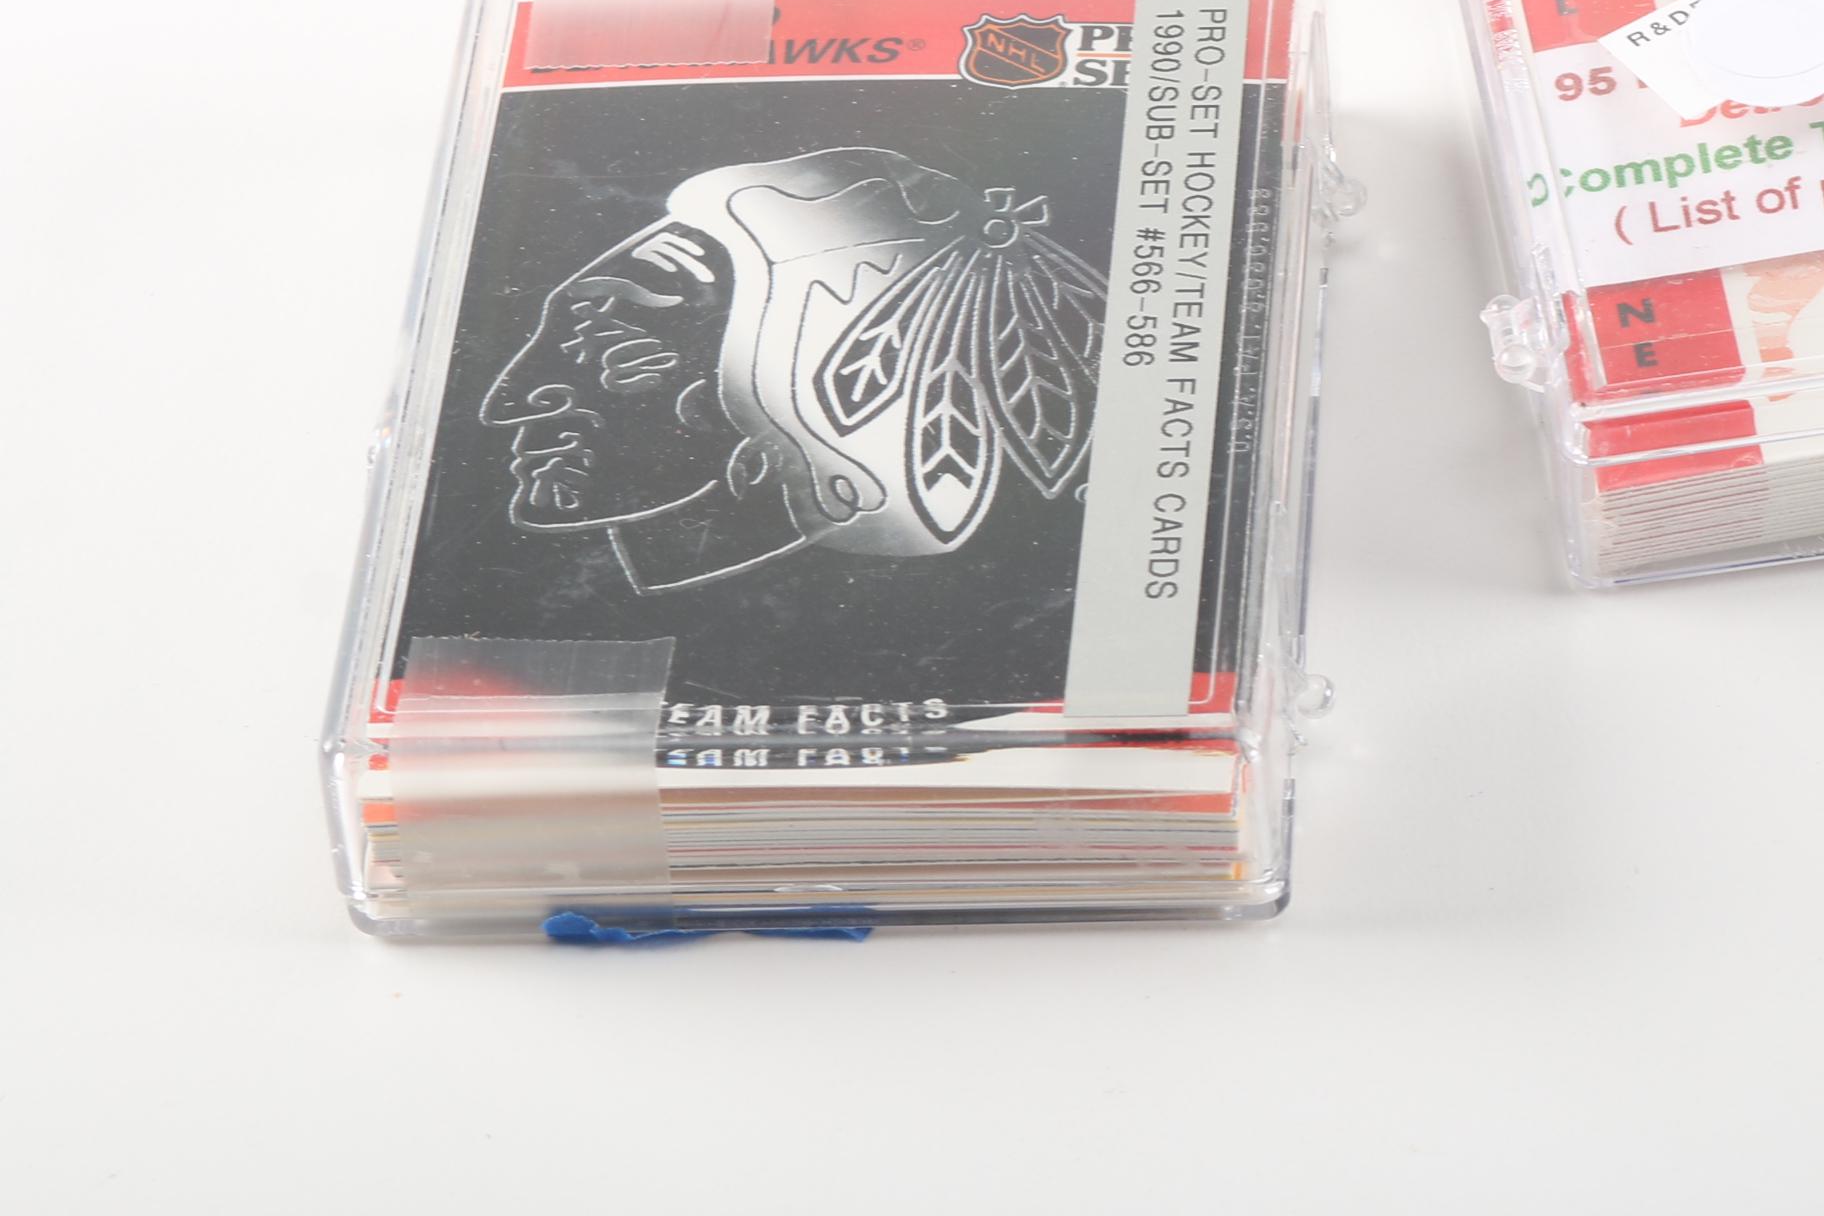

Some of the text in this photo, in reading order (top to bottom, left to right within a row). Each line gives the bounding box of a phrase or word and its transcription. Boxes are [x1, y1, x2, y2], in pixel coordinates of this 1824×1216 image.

[984, 31, 1046, 74] NHL
[1626, 30, 1652, 48] R
[1668, 9, 1690, 27] D
[1554, 67, 1619, 102] 95
[1123, 8, 1185, 368] 1990/SUB-SET #566-586
[1649, 190, 1741, 234] List
[1755, 175, 1804, 215] of
[1144, 7, 1228, 600] PRO-SET HOCKEY/TEAM FACTS CARDS
